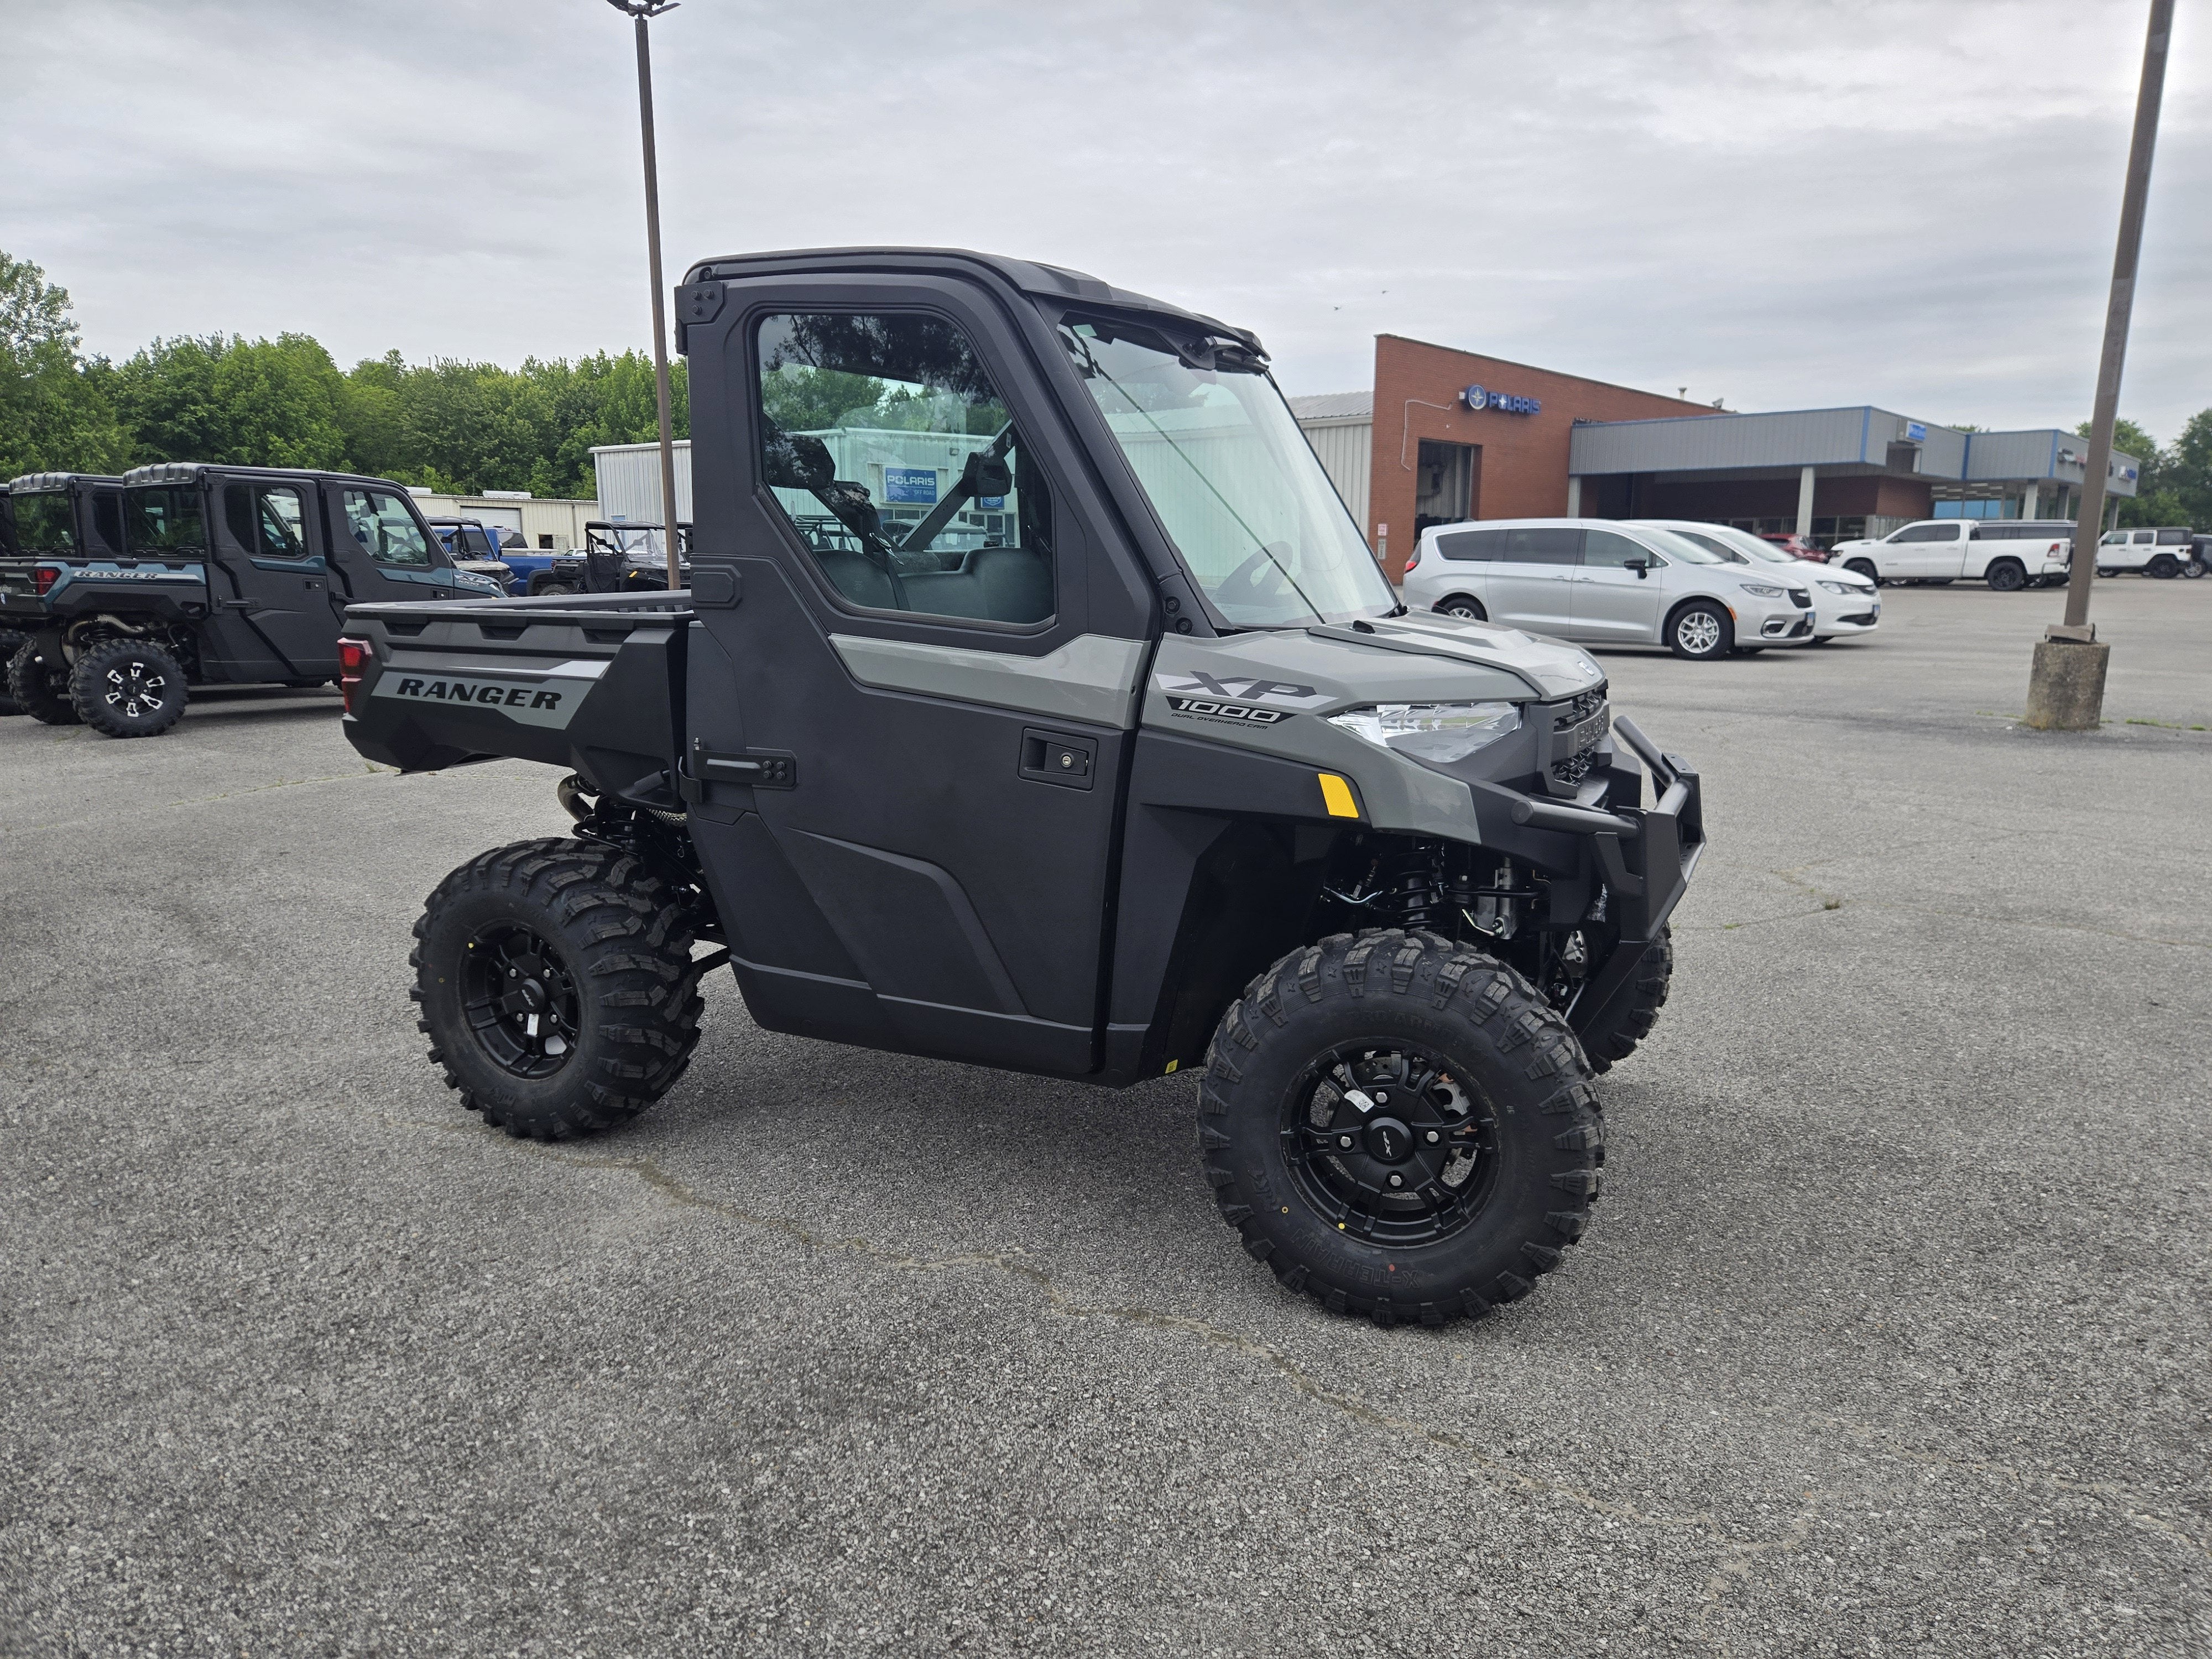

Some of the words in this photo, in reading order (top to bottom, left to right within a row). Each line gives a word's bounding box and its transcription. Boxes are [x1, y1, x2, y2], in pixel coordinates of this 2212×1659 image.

[1489, 392, 1540, 414] POLARIS
[887, 475, 935, 486] POLARIS
[78, 571, 158, 579] RANGER
[396, 678, 562, 711] RANGER
[1165, 670, 1318, 700] XP
[1178, 699, 1281, 723] 1000
[1197, 716, 1245, 727] OVERHEAD
[1289, 1228, 1420, 1289] X-TERRAIN
